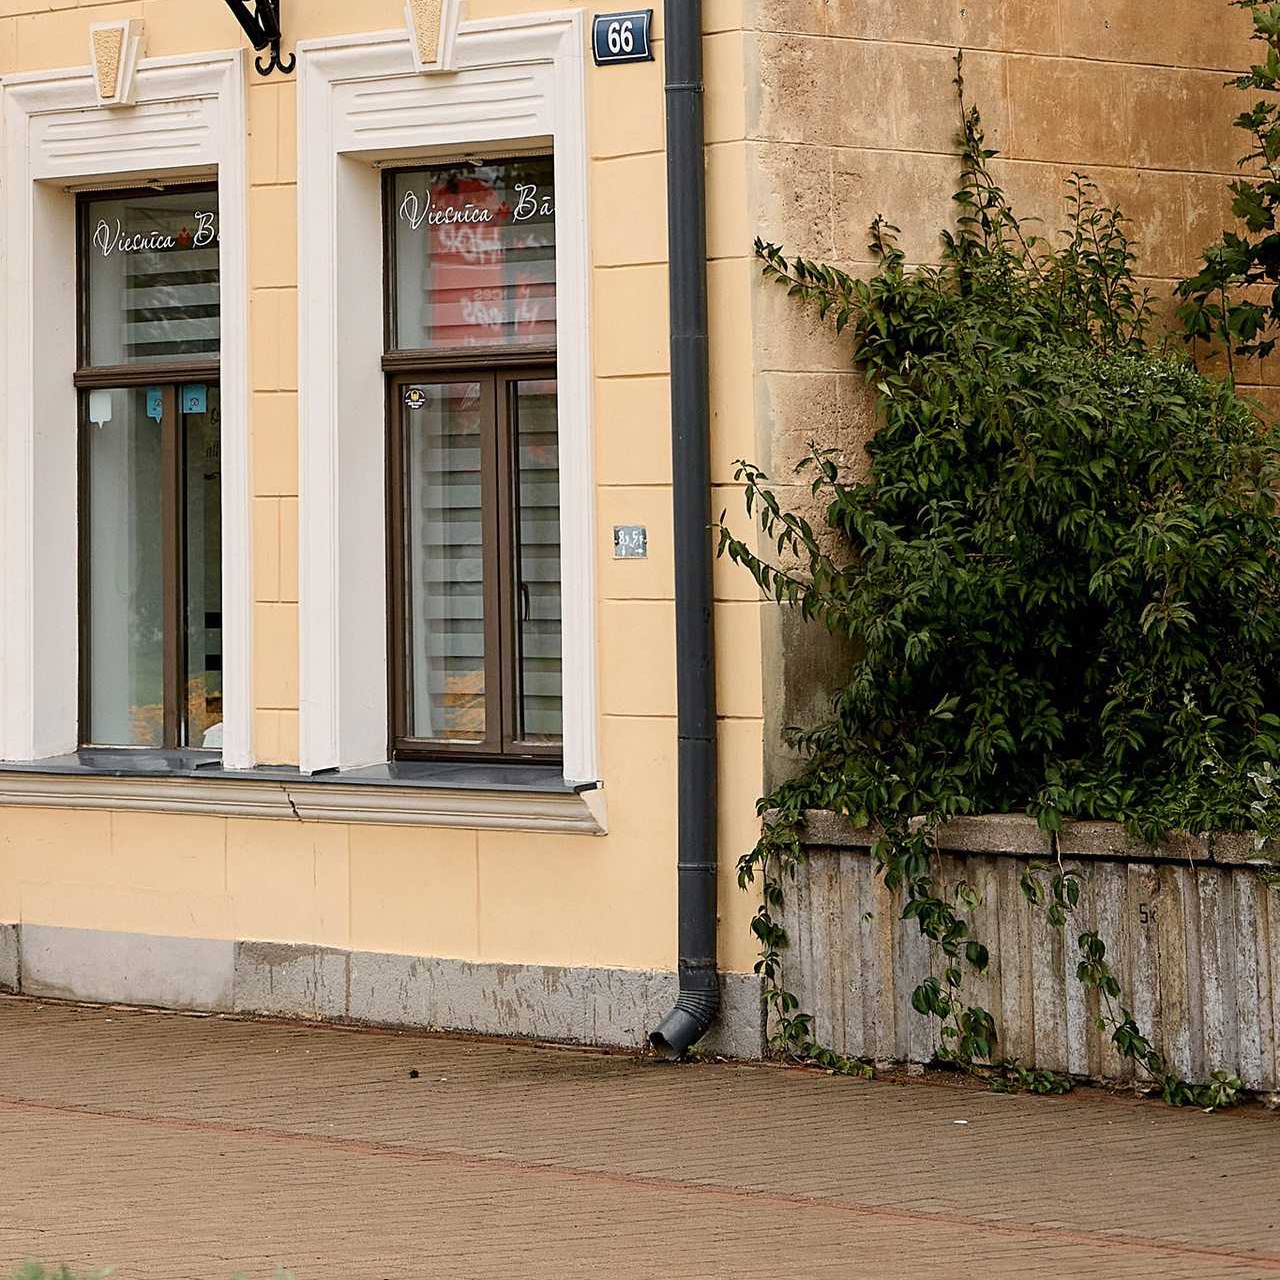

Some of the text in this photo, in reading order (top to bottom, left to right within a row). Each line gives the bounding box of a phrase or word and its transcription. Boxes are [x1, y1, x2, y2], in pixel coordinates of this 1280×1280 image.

[607, 20, 634, 54] 66
[399, 183, 556, 230] Viesnīca Bā
[93, 211, 220, 256] Viesnīca B
